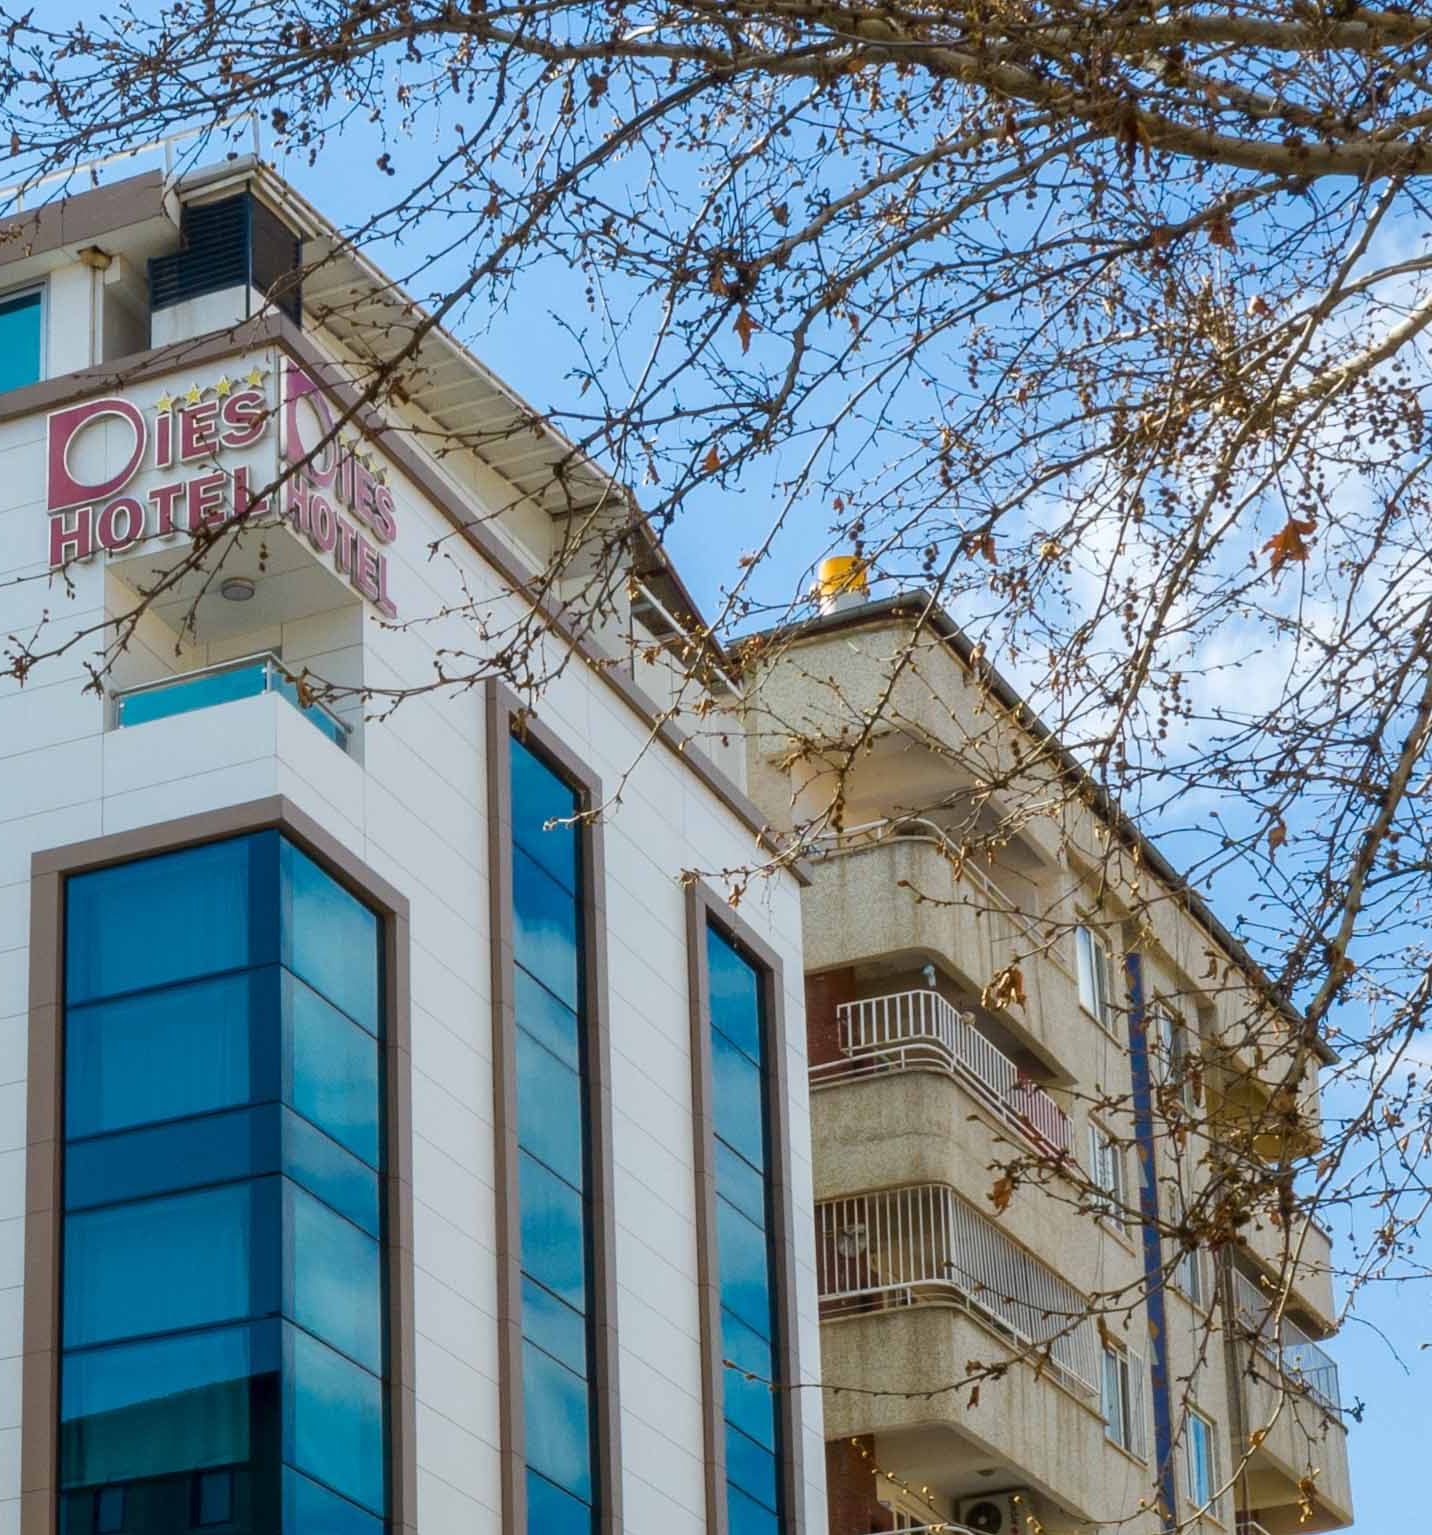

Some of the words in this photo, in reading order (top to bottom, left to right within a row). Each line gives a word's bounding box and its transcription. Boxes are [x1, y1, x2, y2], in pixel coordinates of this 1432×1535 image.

[47, 390, 267, 513] DIES
[48, 465, 272, 568] HOTEL
[286, 472, 398, 618] HOTEL
